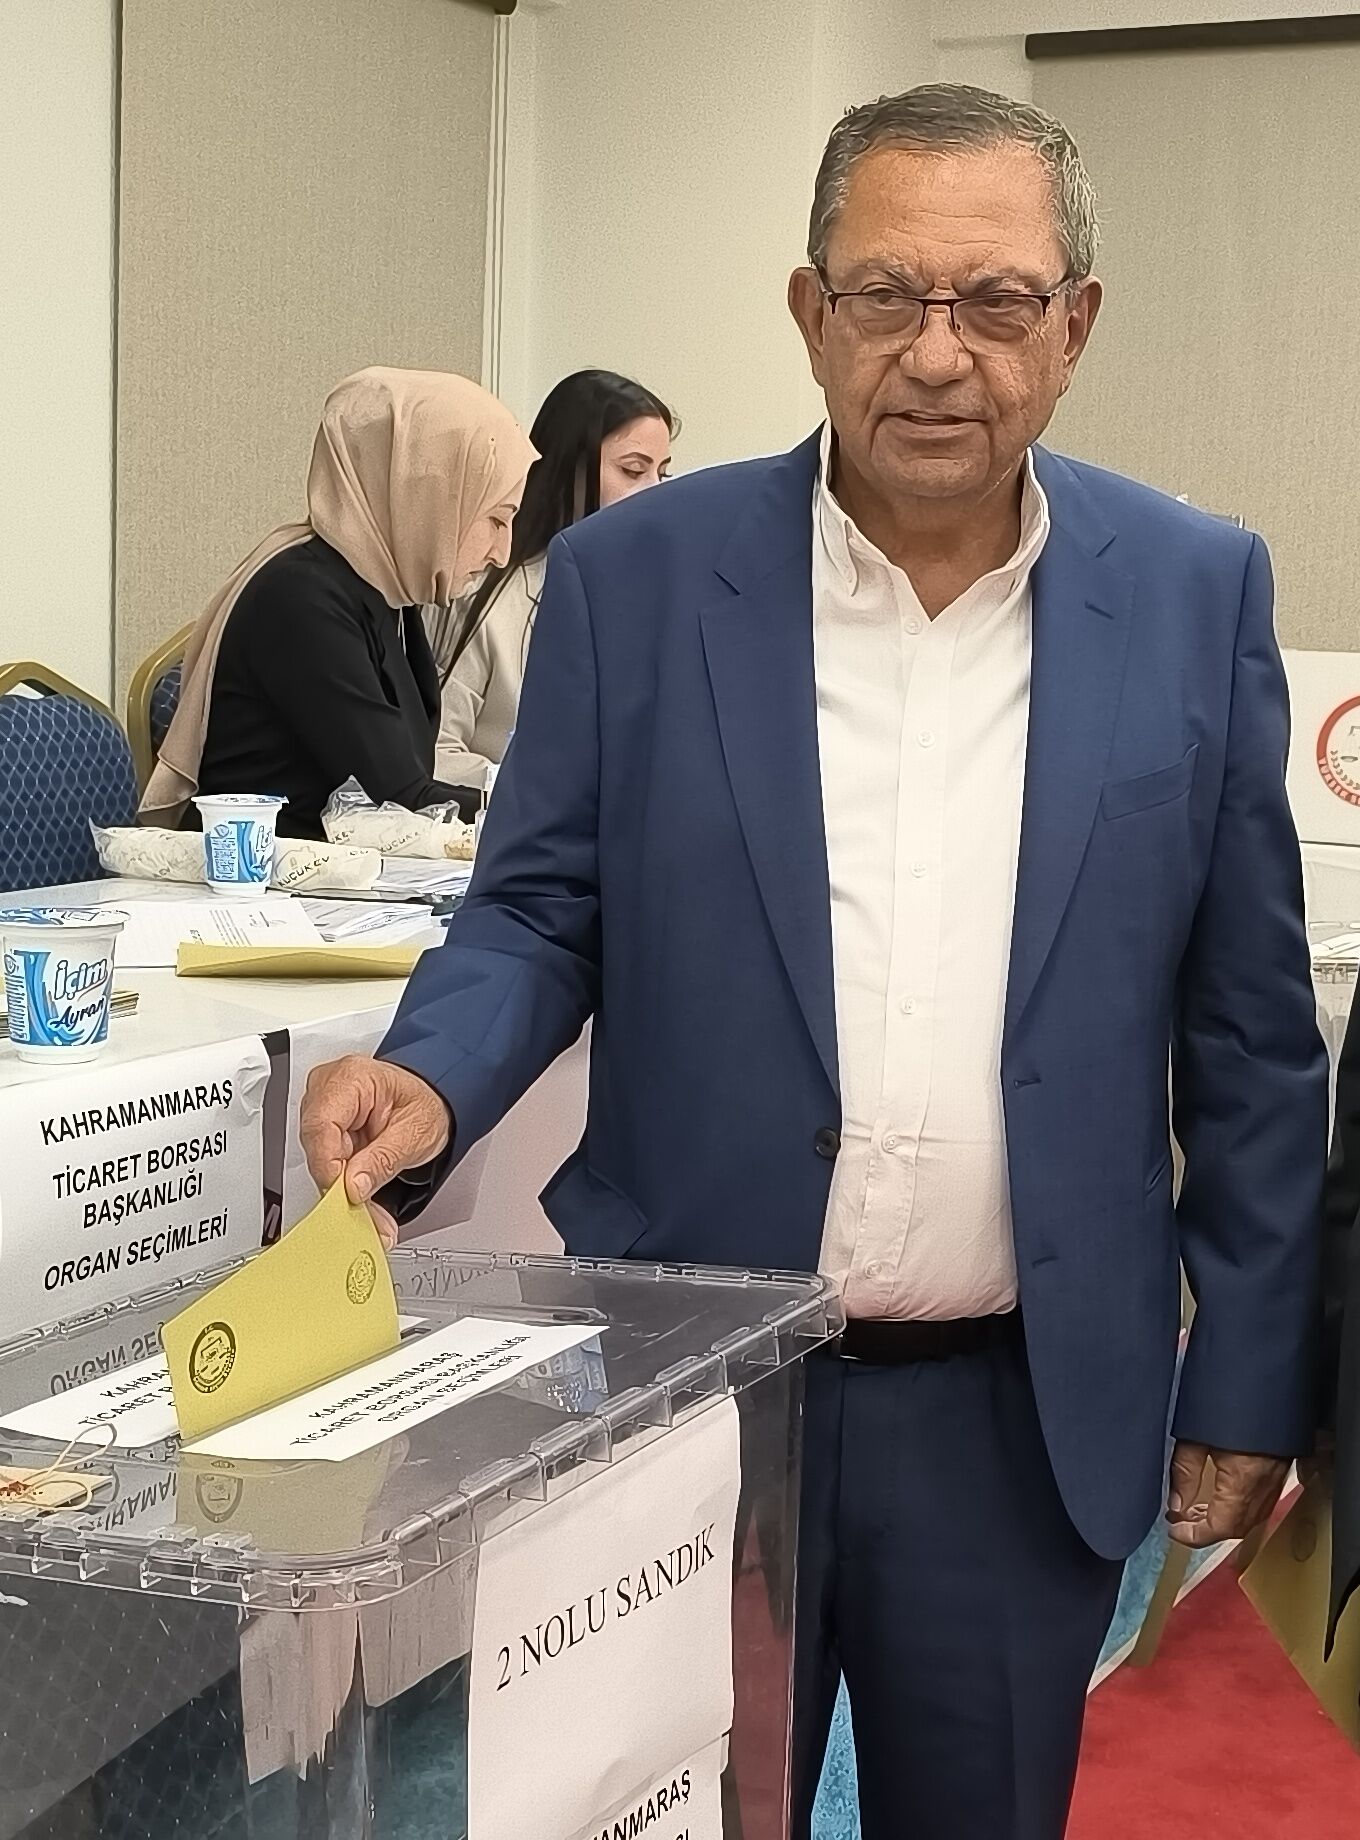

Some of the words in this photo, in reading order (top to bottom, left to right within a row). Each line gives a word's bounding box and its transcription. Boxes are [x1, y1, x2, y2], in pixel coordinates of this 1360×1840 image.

[40, 1079, 233, 1146] KAHRAMANMARAŞ
[52, 1153, 142, 1199] TİCARET
[147, 1129, 228, 1174] BORSASI
[83, 1168, 203, 1229] BAŞKANLIĞI
[44, 1246, 122, 1291] ORGAN
[126, 1207, 228, 1266] SEÇİMLERİ
[496, 1646, 511, 1691] 2
[519, 1587, 607, 1677] NOLU
[616, 1522, 715, 1619] SANDIK
